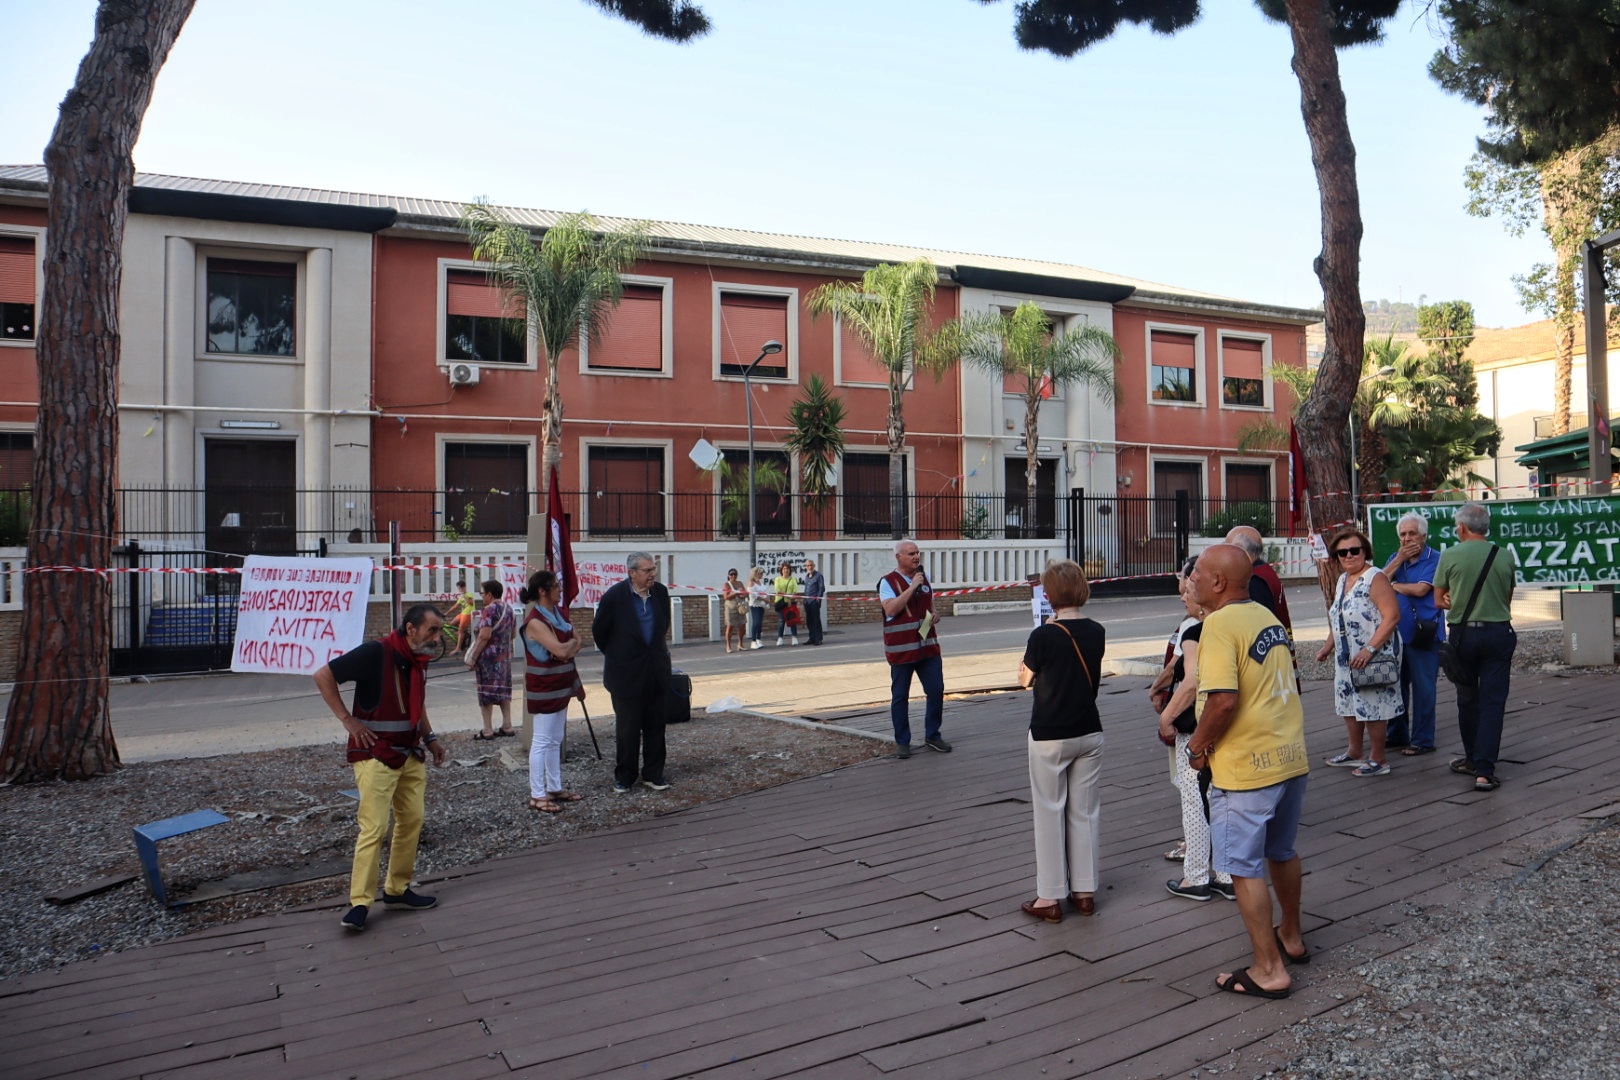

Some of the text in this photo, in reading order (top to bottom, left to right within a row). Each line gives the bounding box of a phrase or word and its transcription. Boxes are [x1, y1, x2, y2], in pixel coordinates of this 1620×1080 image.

[1501, 502, 1518, 516] di
[1537, 499, 1612, 516] SANTA
[1500, 521, 1566, 540] DELUSI,
[1534, 567, 1590, 583] SANTA
[1256, 627, 1289, 656] OSAK
